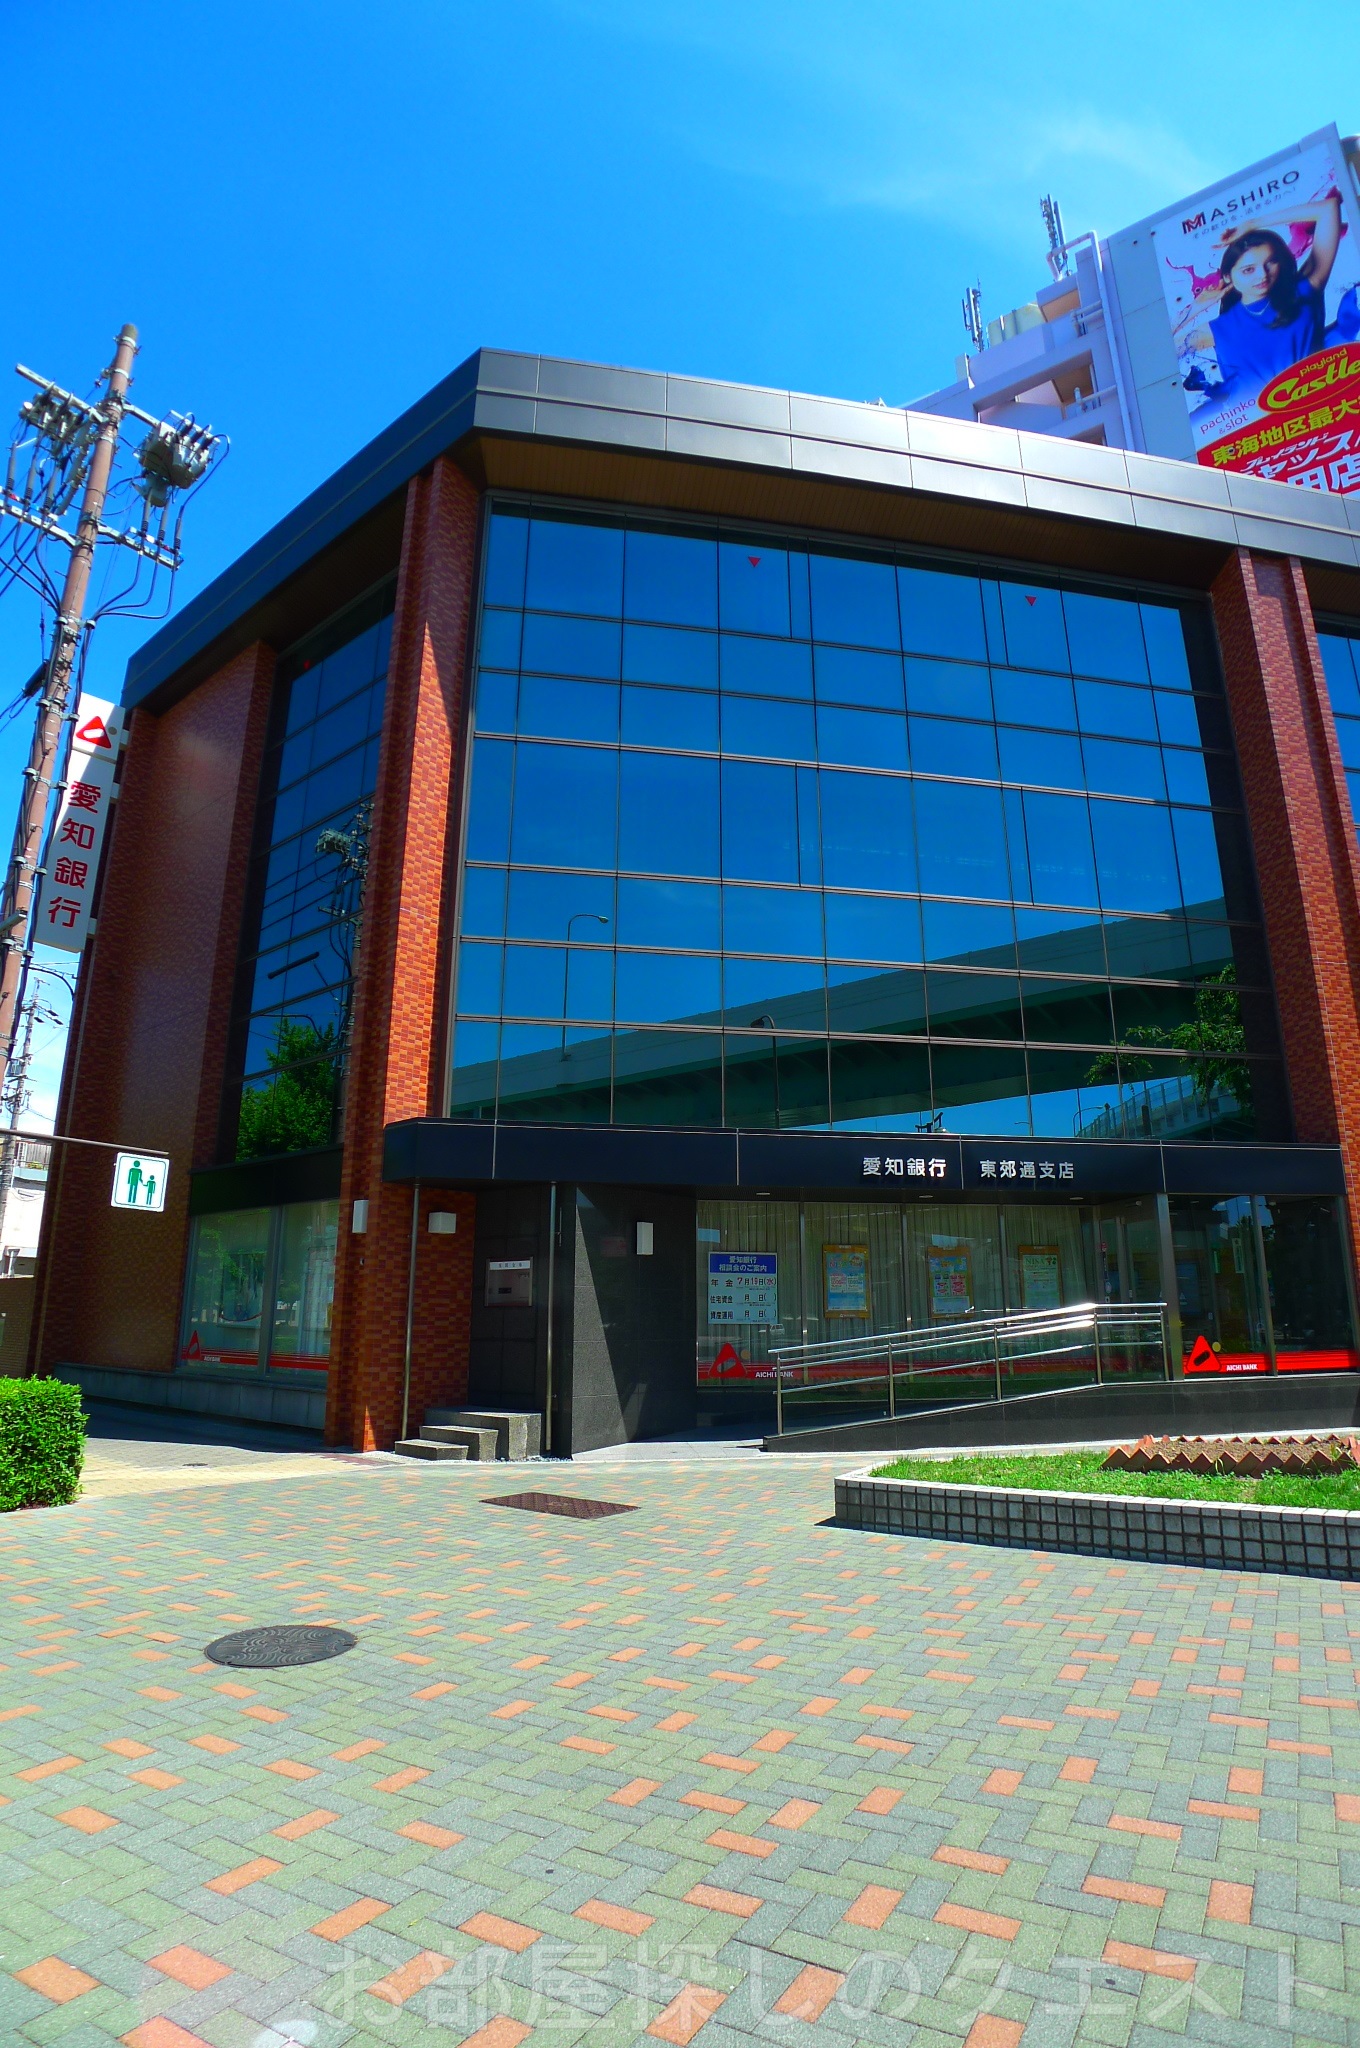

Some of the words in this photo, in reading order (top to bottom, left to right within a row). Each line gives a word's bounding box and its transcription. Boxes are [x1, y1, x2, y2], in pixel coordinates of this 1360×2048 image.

[1182, 171, 1300, 235] MASHIRO
[1300, 347, 1348, 378] playland
[1200, 398, 1257, 435] pachinko
[1211, 396, 1360, 468] 東海地区最大
[1225, 413, 1249, 431] slot
[48, 780, 102, 929] 愛知銀行
[862, 1156, 947, 1178] 愛知銀行
[980, 1159, 1075, 1180] 東郊通支店
